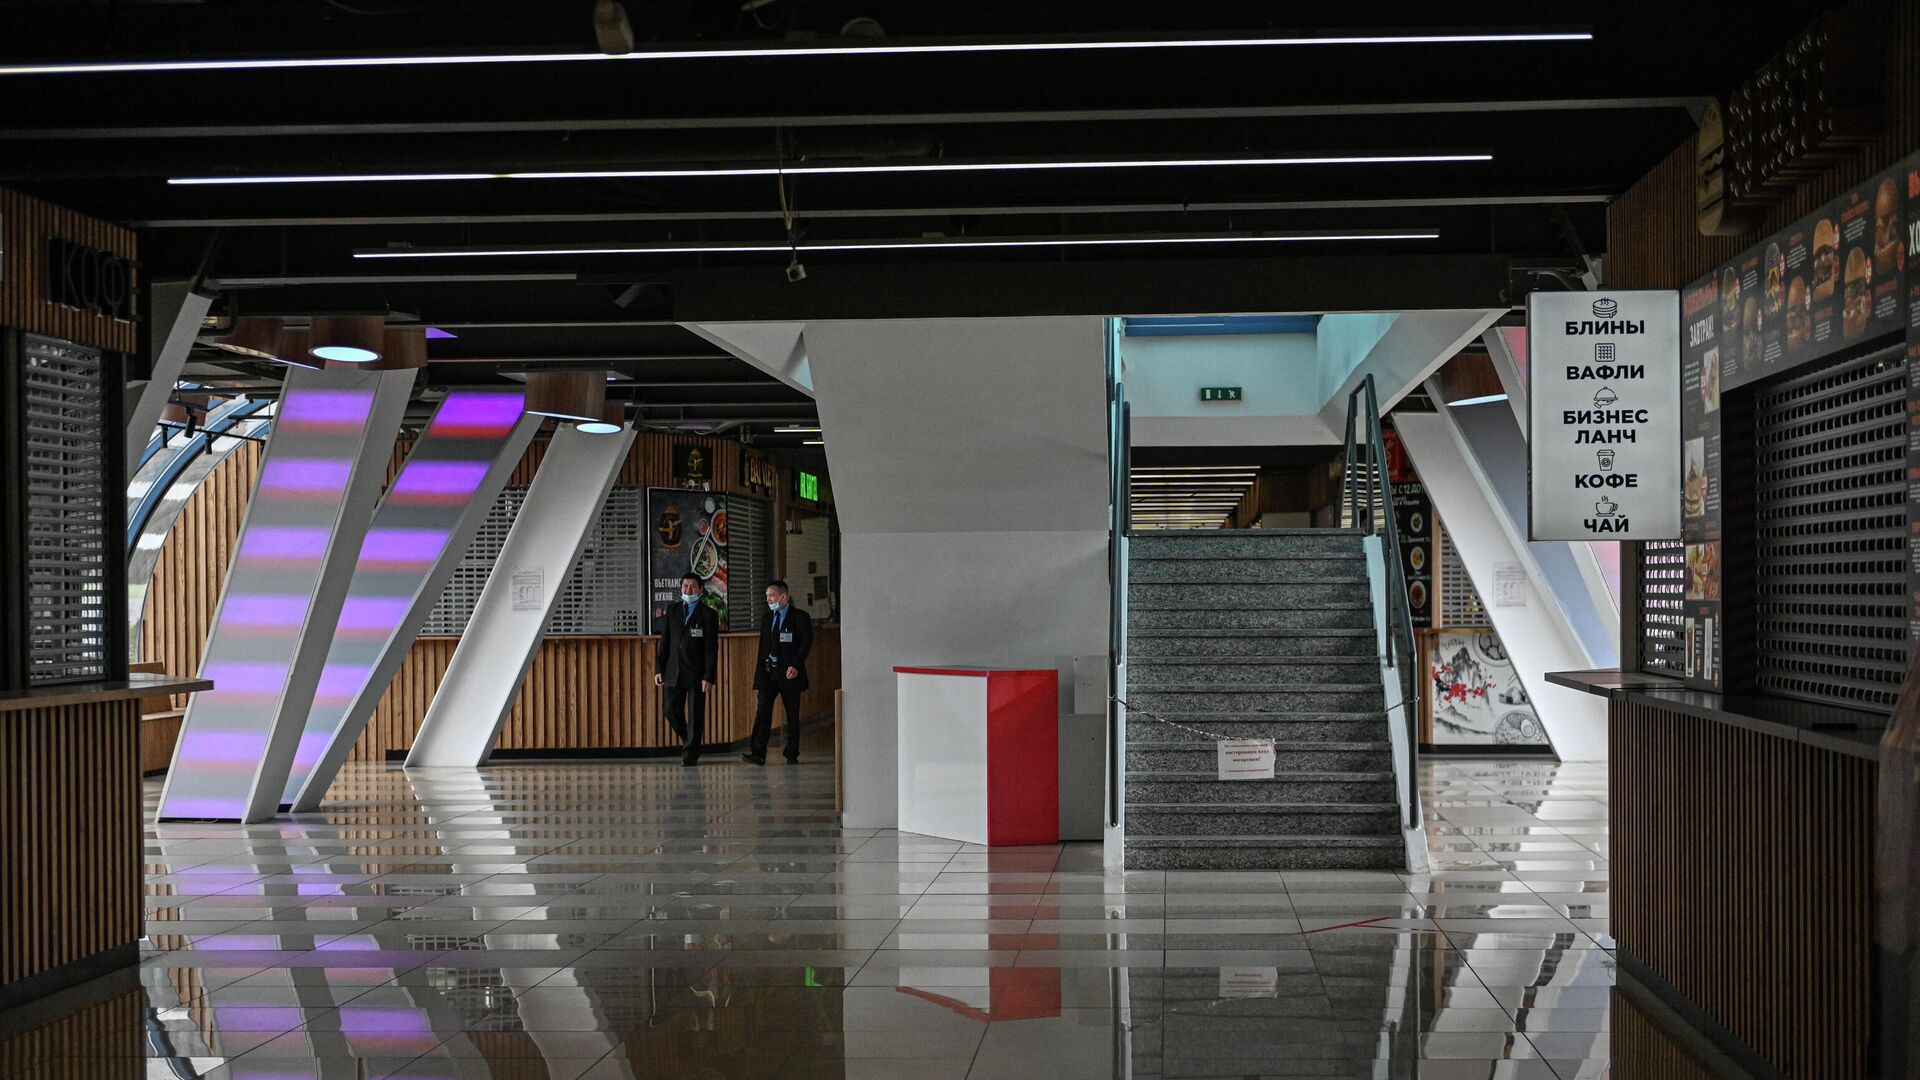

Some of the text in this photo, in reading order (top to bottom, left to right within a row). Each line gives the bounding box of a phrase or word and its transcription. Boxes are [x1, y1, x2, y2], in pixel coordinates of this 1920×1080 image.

[1566, 320, 1644, 335] БЛИНЫ
[1690, 314, 1714, 348] ЗАВТРАК!
[1567, 365, 1644, 380] ВАФЛИ
[1564, 408, 1648, 424] БИЗНЕС
[1575, 430, 1635, 444] ЛАНЧ
[1575, 474, 1637, 488] КОФЕ
[1584, 515, 1628, 532] ЧАЙ
[654, 578, 681, 588] ВЬЕТНАМС
